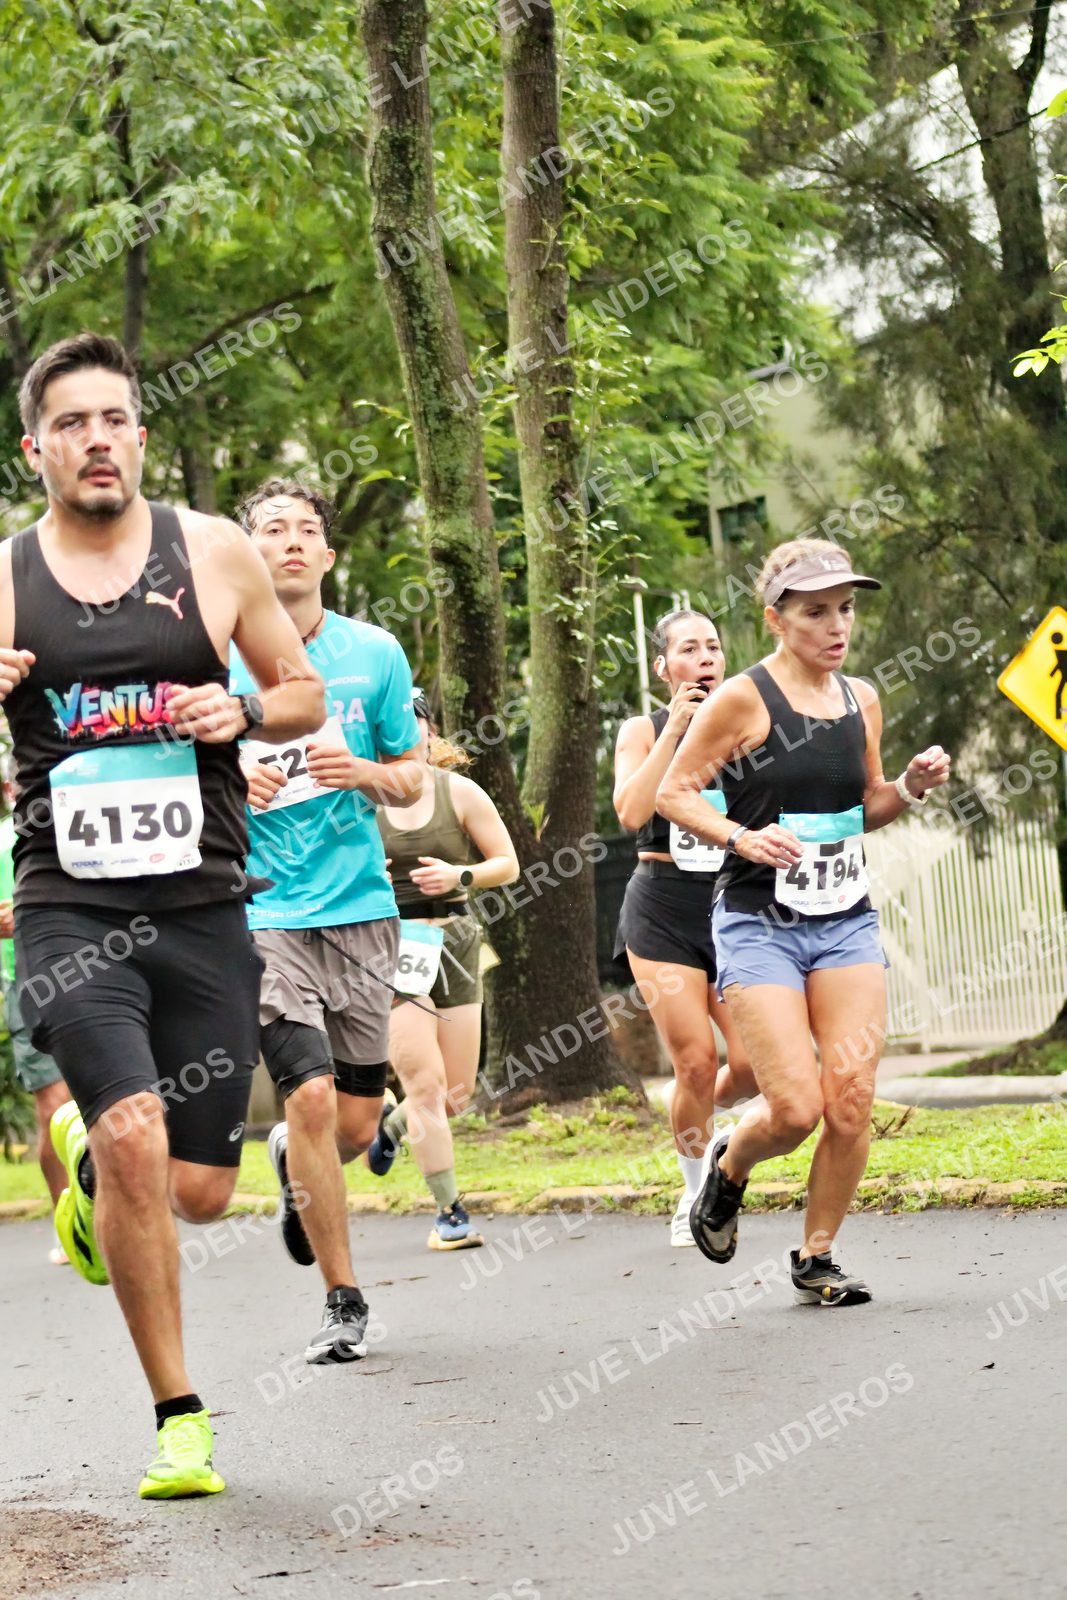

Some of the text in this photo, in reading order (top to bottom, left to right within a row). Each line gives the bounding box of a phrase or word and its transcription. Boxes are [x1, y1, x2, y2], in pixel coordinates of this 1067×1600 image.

[258, 746, 310, 779] 52
[68, 800, 192, 847] 4130
[785, 853, 860, 891] 4194
